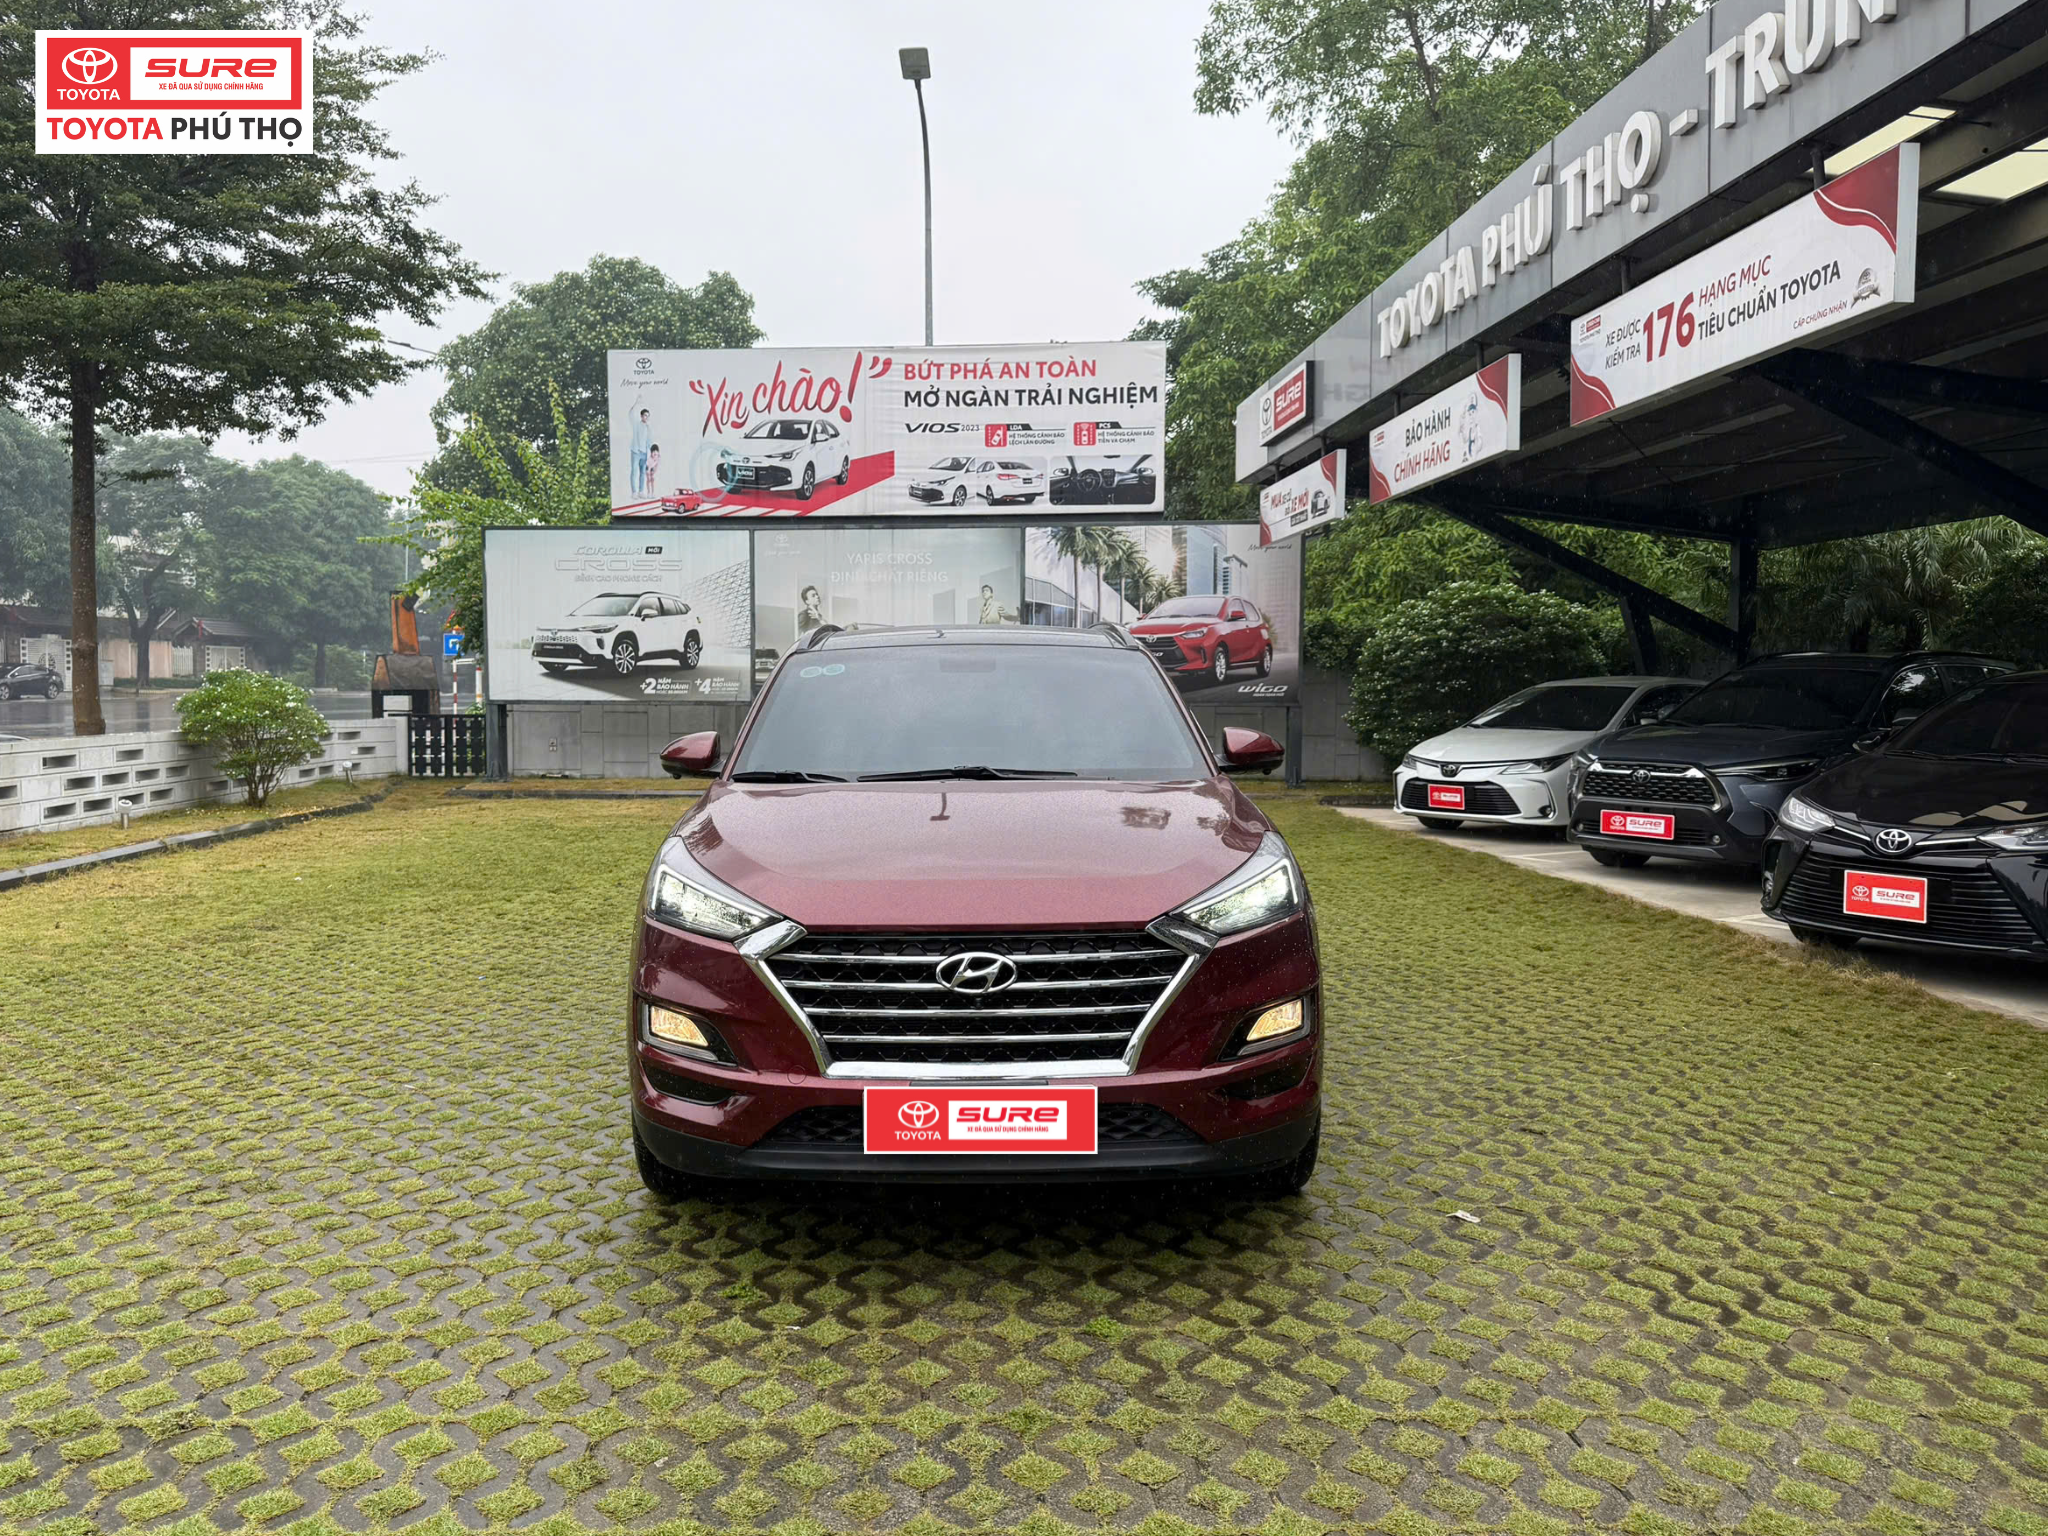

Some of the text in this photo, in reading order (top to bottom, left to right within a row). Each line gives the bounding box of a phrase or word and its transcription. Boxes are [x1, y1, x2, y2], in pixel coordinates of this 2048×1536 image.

[1377, 246, 1477, 359] TOYOTA
[1482, 164, 1552, 287] PHÚ
[1560, 111, 1661, 230] THỌ
[1699, 254, 1771, 307] HẠNG MỤC
[1698, 260, 1841, 340] TIÊU CHUẨN TOYOTA
[1605, 331, 1616, 348] XE
[1616, 319, 1641, 342] ĐƯỢC
[1643, 291, 1695, 363] 176
[1605, 342, 1641, 369] KIỂM TRA
[904, 355, 1096, 381] BỨT PHÁ AN TOÀN
[904, 382, 1158, 409] MỞ NGÀN TRẢI NGHIỆM
[904, 423, 980, 434] VIOS 2023
[1405, 418, 1423, 447] BẢO
[1424, 406, 1451, 438] HÀNH
[1394, 440, 1451, 482] CHÍNH HÃNG
[575, 546, 644, 556] COROLLA
[887, 551, 933, 565] CROSS
[555, 559, 683, 571] CROSS
[907, 568, 949, 583] RIÊNG
[640, 677, 657, 694] +2
[694, 677, 711, 694] +4
[1876, 890, 1915, 901] SURE
[956, 1106, 1060, 1123] SURE
[895, 1130, 942, 1141] TOYOTA
